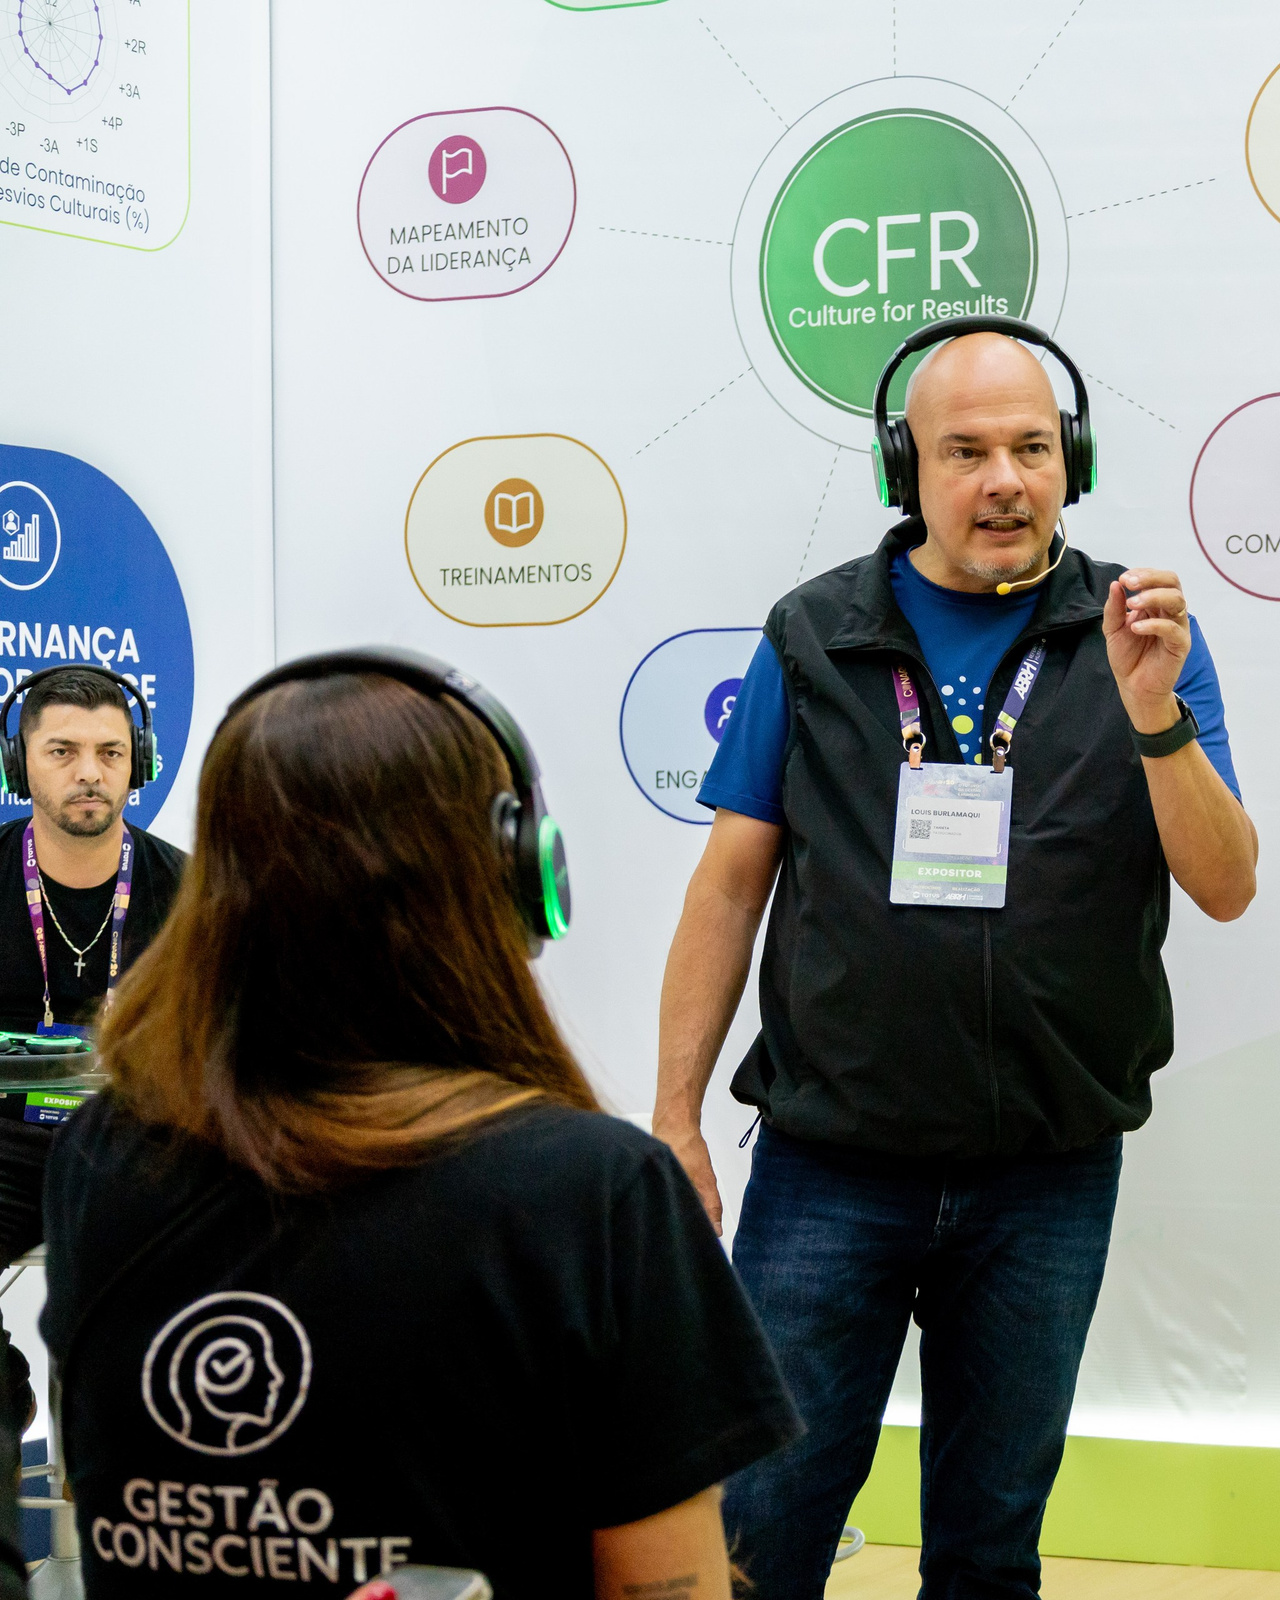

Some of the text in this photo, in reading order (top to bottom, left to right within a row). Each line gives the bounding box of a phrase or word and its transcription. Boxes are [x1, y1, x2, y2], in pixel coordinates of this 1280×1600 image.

[125, 38, 146, 55] +2R
[119, 83, 141, 100] +3A
[5, 121, 26, 137] -3P
[101, 116, 123, 131] +4P
[39, 138, 60, 154] -3A
[76, 138, 98, 153] +1S
[25, 162, 146, 204] Contaminação
[50, 195, 121, 224] Culturais
[125, 206, 150, 233] (%)
[390, 217, 529, 245] MAPEAMENTO
[387, 247, 532, 275] DA LIDERANÇA
[813, 210, 982, 297] CFR
[788, 294, 1009, 328] Culture for Results
[440, 563, 592, 587] TREINAMENTOS
[0, 620, 140, 669] RNANÇA
[911, 808, 981, 818] LOUIS BURLAMAQUI
[917, 867, 982, 878] EXPOSITOR
[122, 1478, 334, 1534] GESTÃO
[92, 1517, 412, 1584] CONSCIENTE
